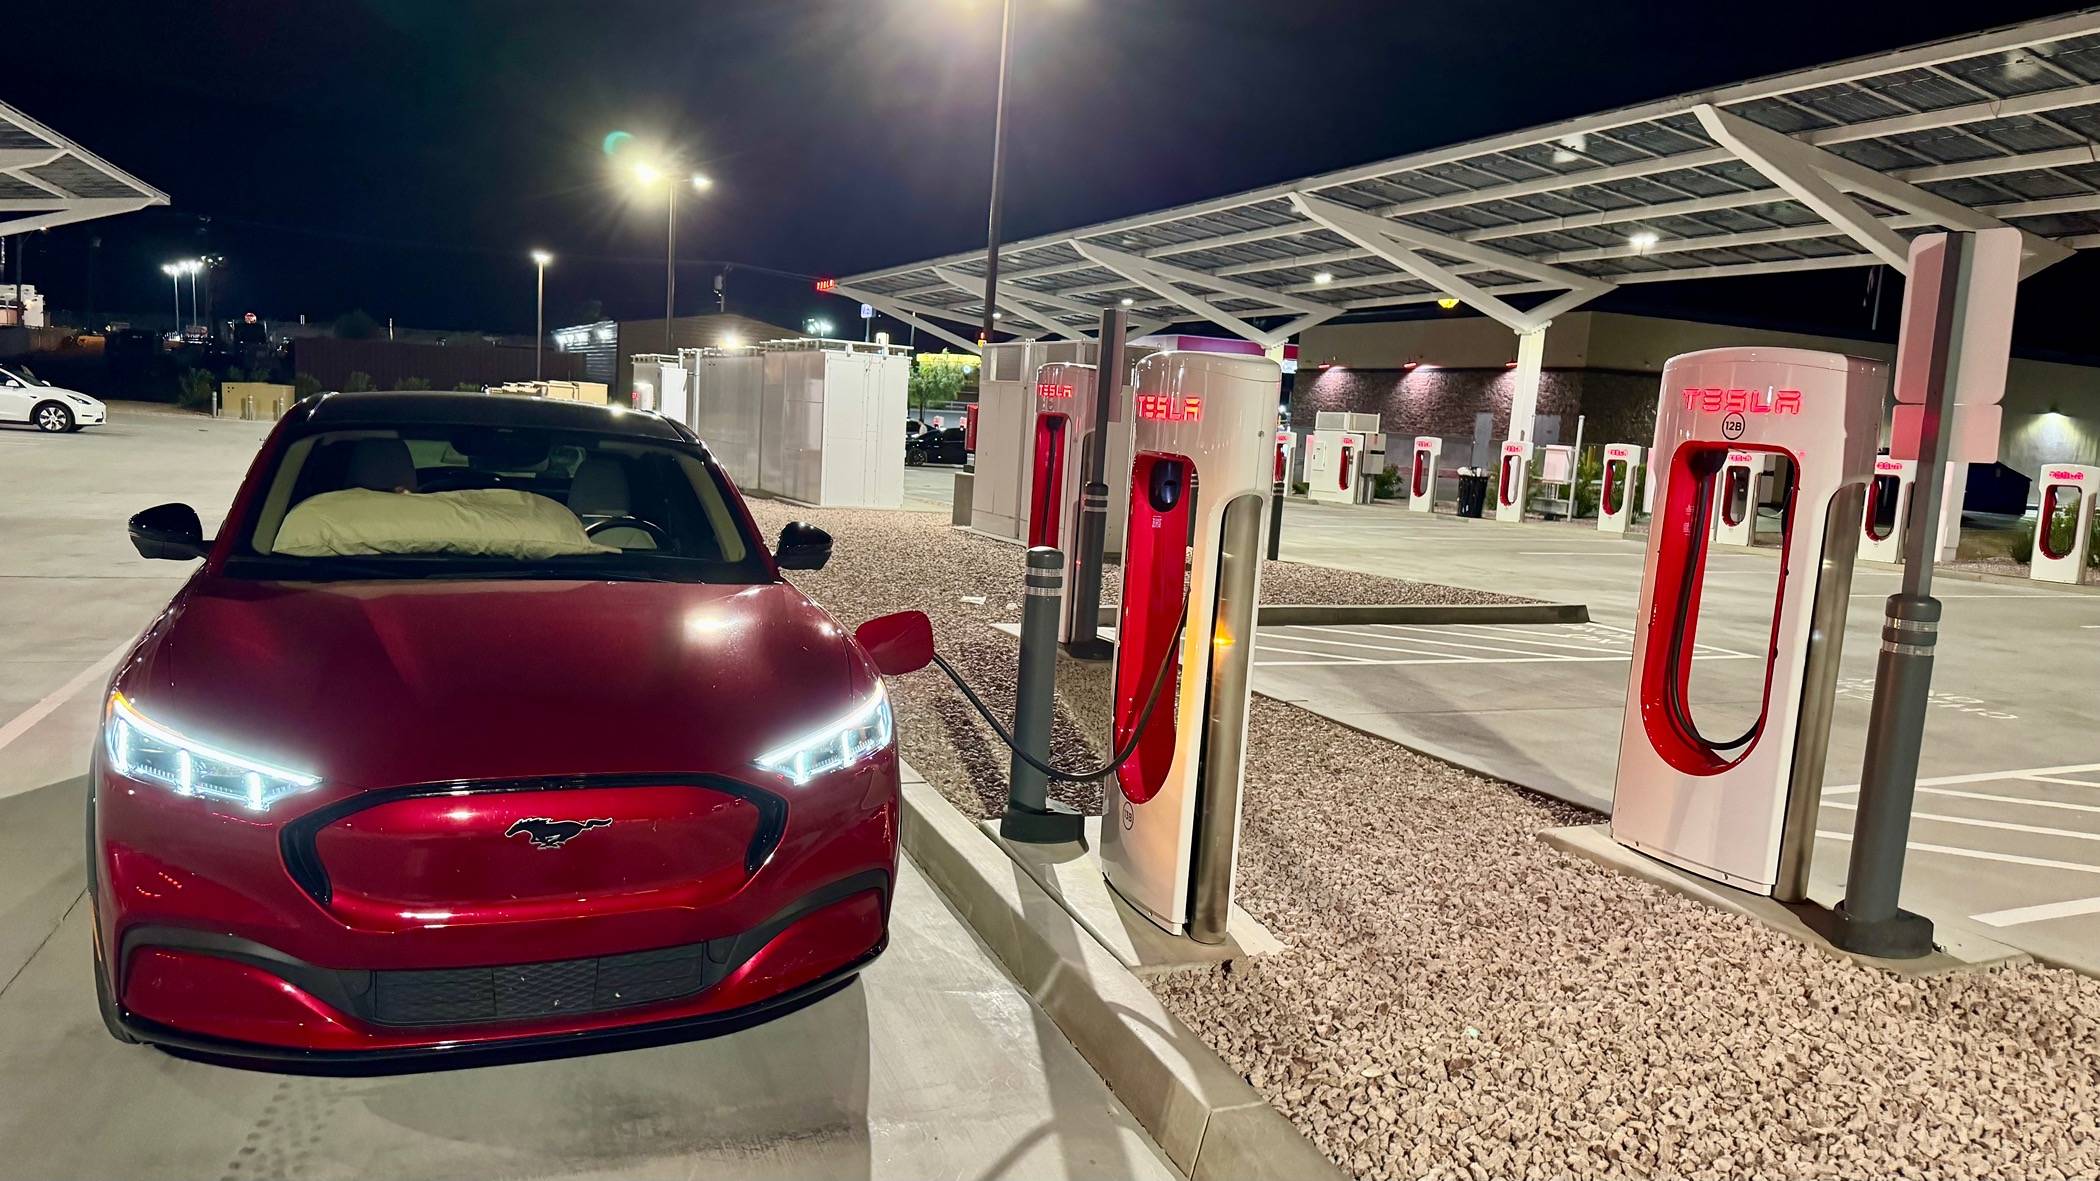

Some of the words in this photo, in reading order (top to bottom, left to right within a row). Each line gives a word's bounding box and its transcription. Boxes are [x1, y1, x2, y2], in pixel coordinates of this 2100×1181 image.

[1039, 384, 1072, 398] TESLA
[1138, 395, 1200, 421] TESLA
[1684, 389, 1801, 414] TESLA
[1725, 421, 1742, 431] 12B
